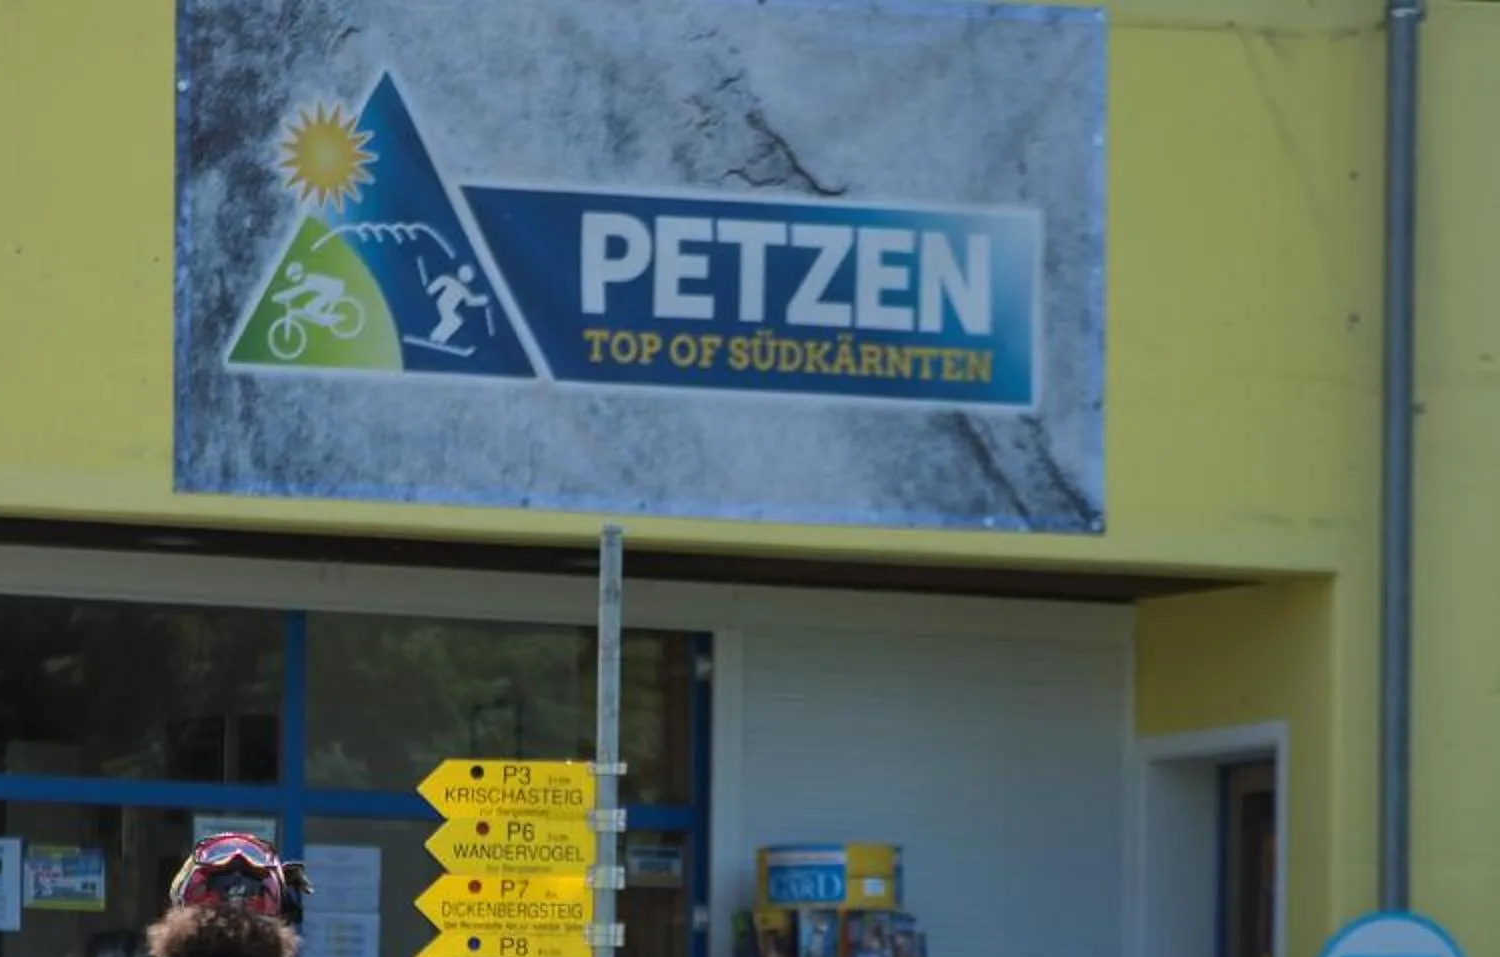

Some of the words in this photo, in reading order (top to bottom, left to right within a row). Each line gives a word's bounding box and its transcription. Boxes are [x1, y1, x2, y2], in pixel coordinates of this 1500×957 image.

[581, 211, 992, 336] PETZEN
[585, 330, 661, 364] TOP
[670, 334, 722, 368] OF
[729, 330, 993, 383] SÜDKÄRNTEN
[503, 764, 531, 786] P3
[444, 786, 584, 806] KRISCHASTEIG
[506, 820, 536, 842] P6
[453, 842, 586, 863] WANDERVOGEL
[500, 879, 530, 899] P7
[441, 901, 584, 920] DICKENBERGSTEIG
[500, 936, 529, 957] P8
